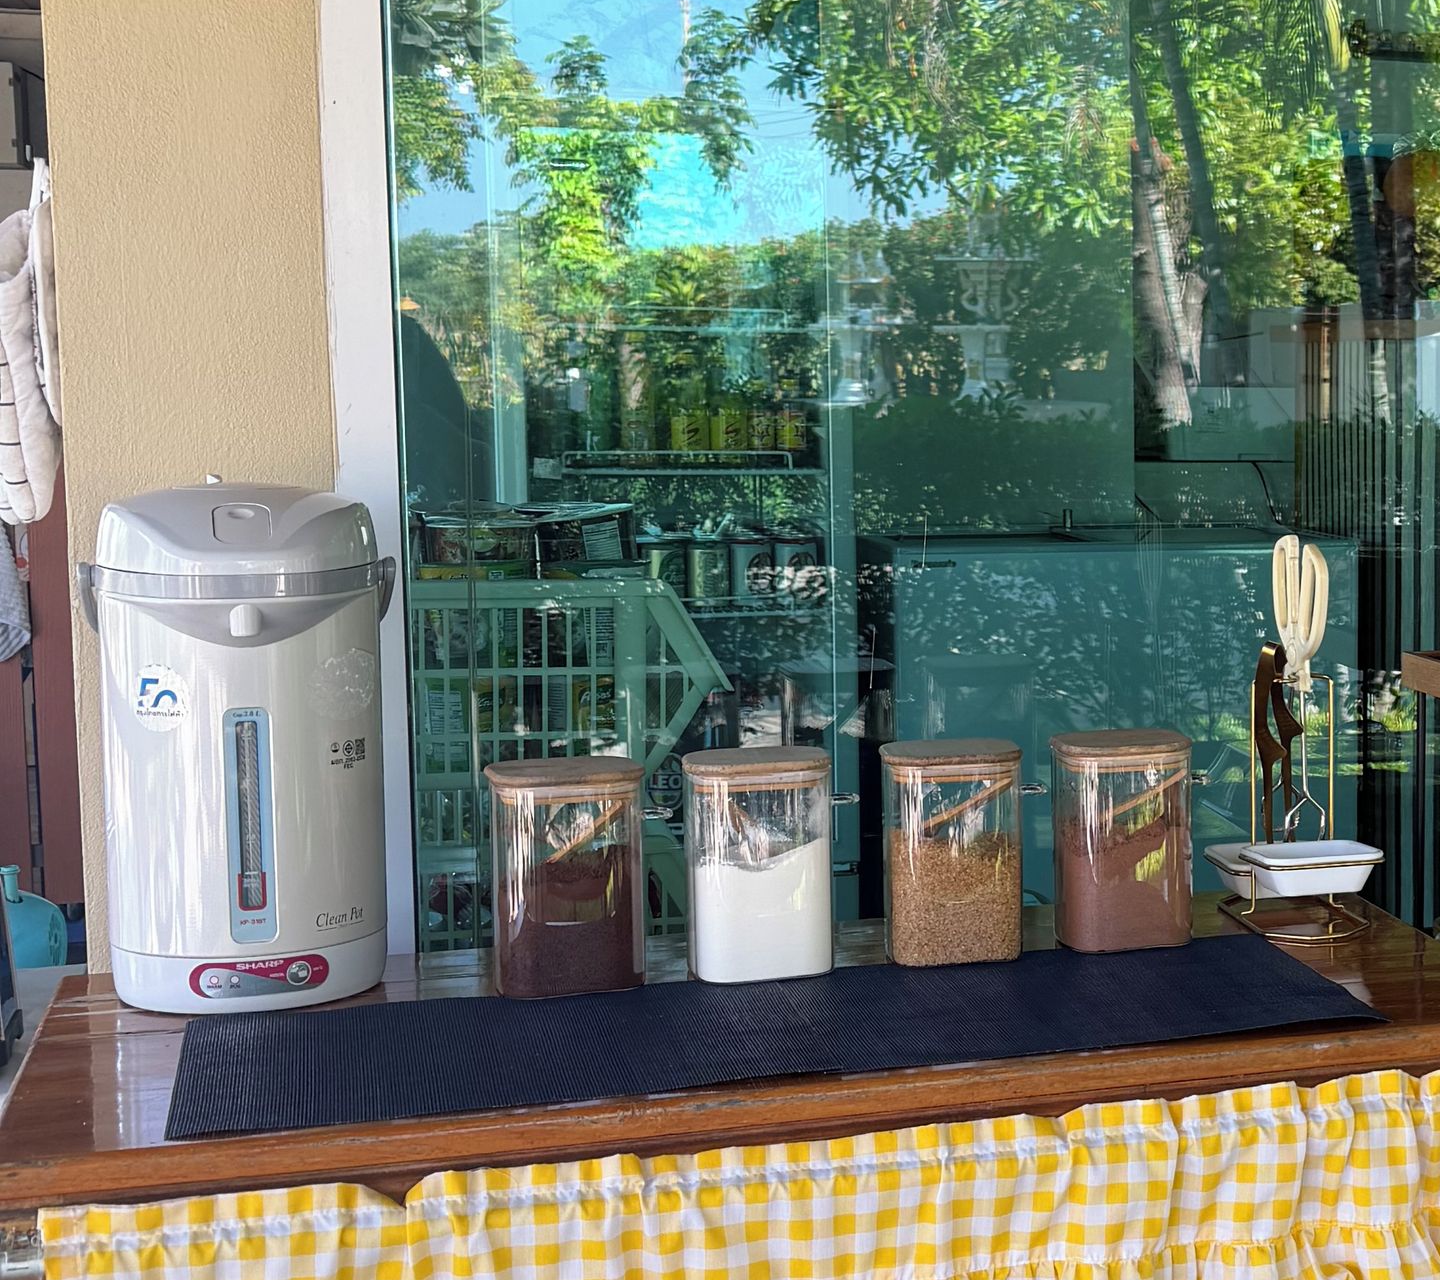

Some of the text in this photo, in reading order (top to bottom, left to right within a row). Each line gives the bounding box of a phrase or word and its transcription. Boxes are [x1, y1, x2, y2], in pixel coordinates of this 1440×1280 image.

[649, 774, 682, 789] LEO
[316, 906, 364, 928] Clean Pot
[236, 959, 285, 971] SHARP
